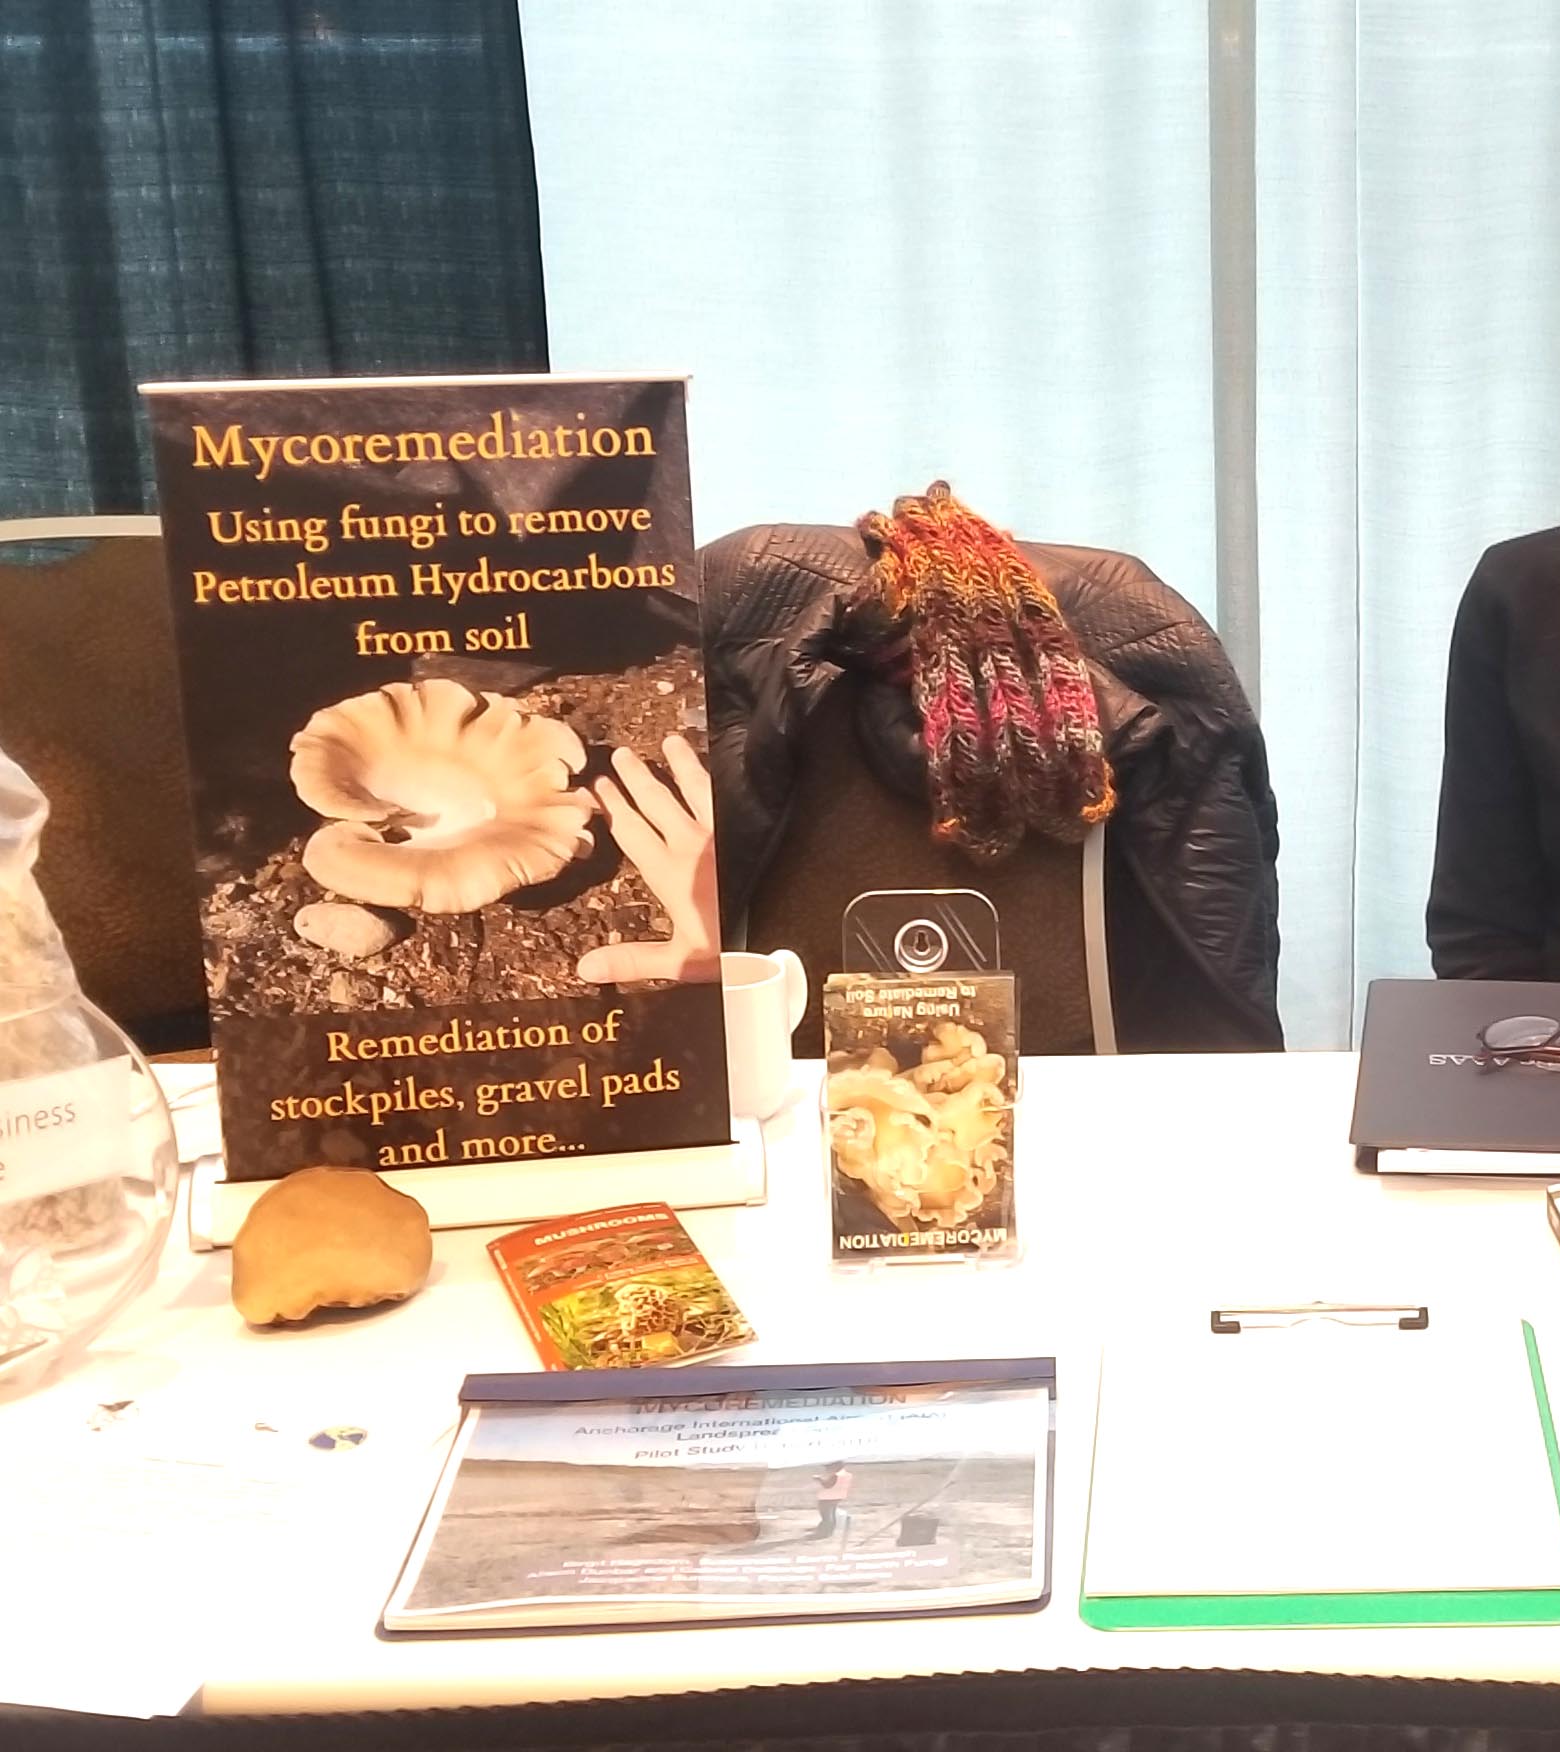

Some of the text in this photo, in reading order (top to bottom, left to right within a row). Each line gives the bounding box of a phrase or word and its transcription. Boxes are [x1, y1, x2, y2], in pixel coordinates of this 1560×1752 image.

[191, 408, 656, 481] Mycoremediation
[208, 502, 652, 552] Using fungi to remove
[193, 552, 676, 604] Petroleum Hydrocarbons
[355, 613, 531, 656] from soil
[845, 985, 977, 1004] to Remediate Soil
[863, 1001, 961, 1019] Using Nature
[327, 1009, 624, 1062] Remediation of
[270, 1058, 682, 1127] stockpiles, gravel pads
[379, 1127, 586, 1167] and more...
[533, 1212, 670, 1247] MUSHROOMS
[839, 1227, 1007, 1250] MYCOREMEDIATION
[636, 1391, 908, 1415] MYCOREMEDIATION
[574, 1420, 686, 1437] Anchorage
[693, 1414, 819, 1431] International
[634, 1447, 680, 1460] Pilot
[687, 1441, 746, 1457] Study
